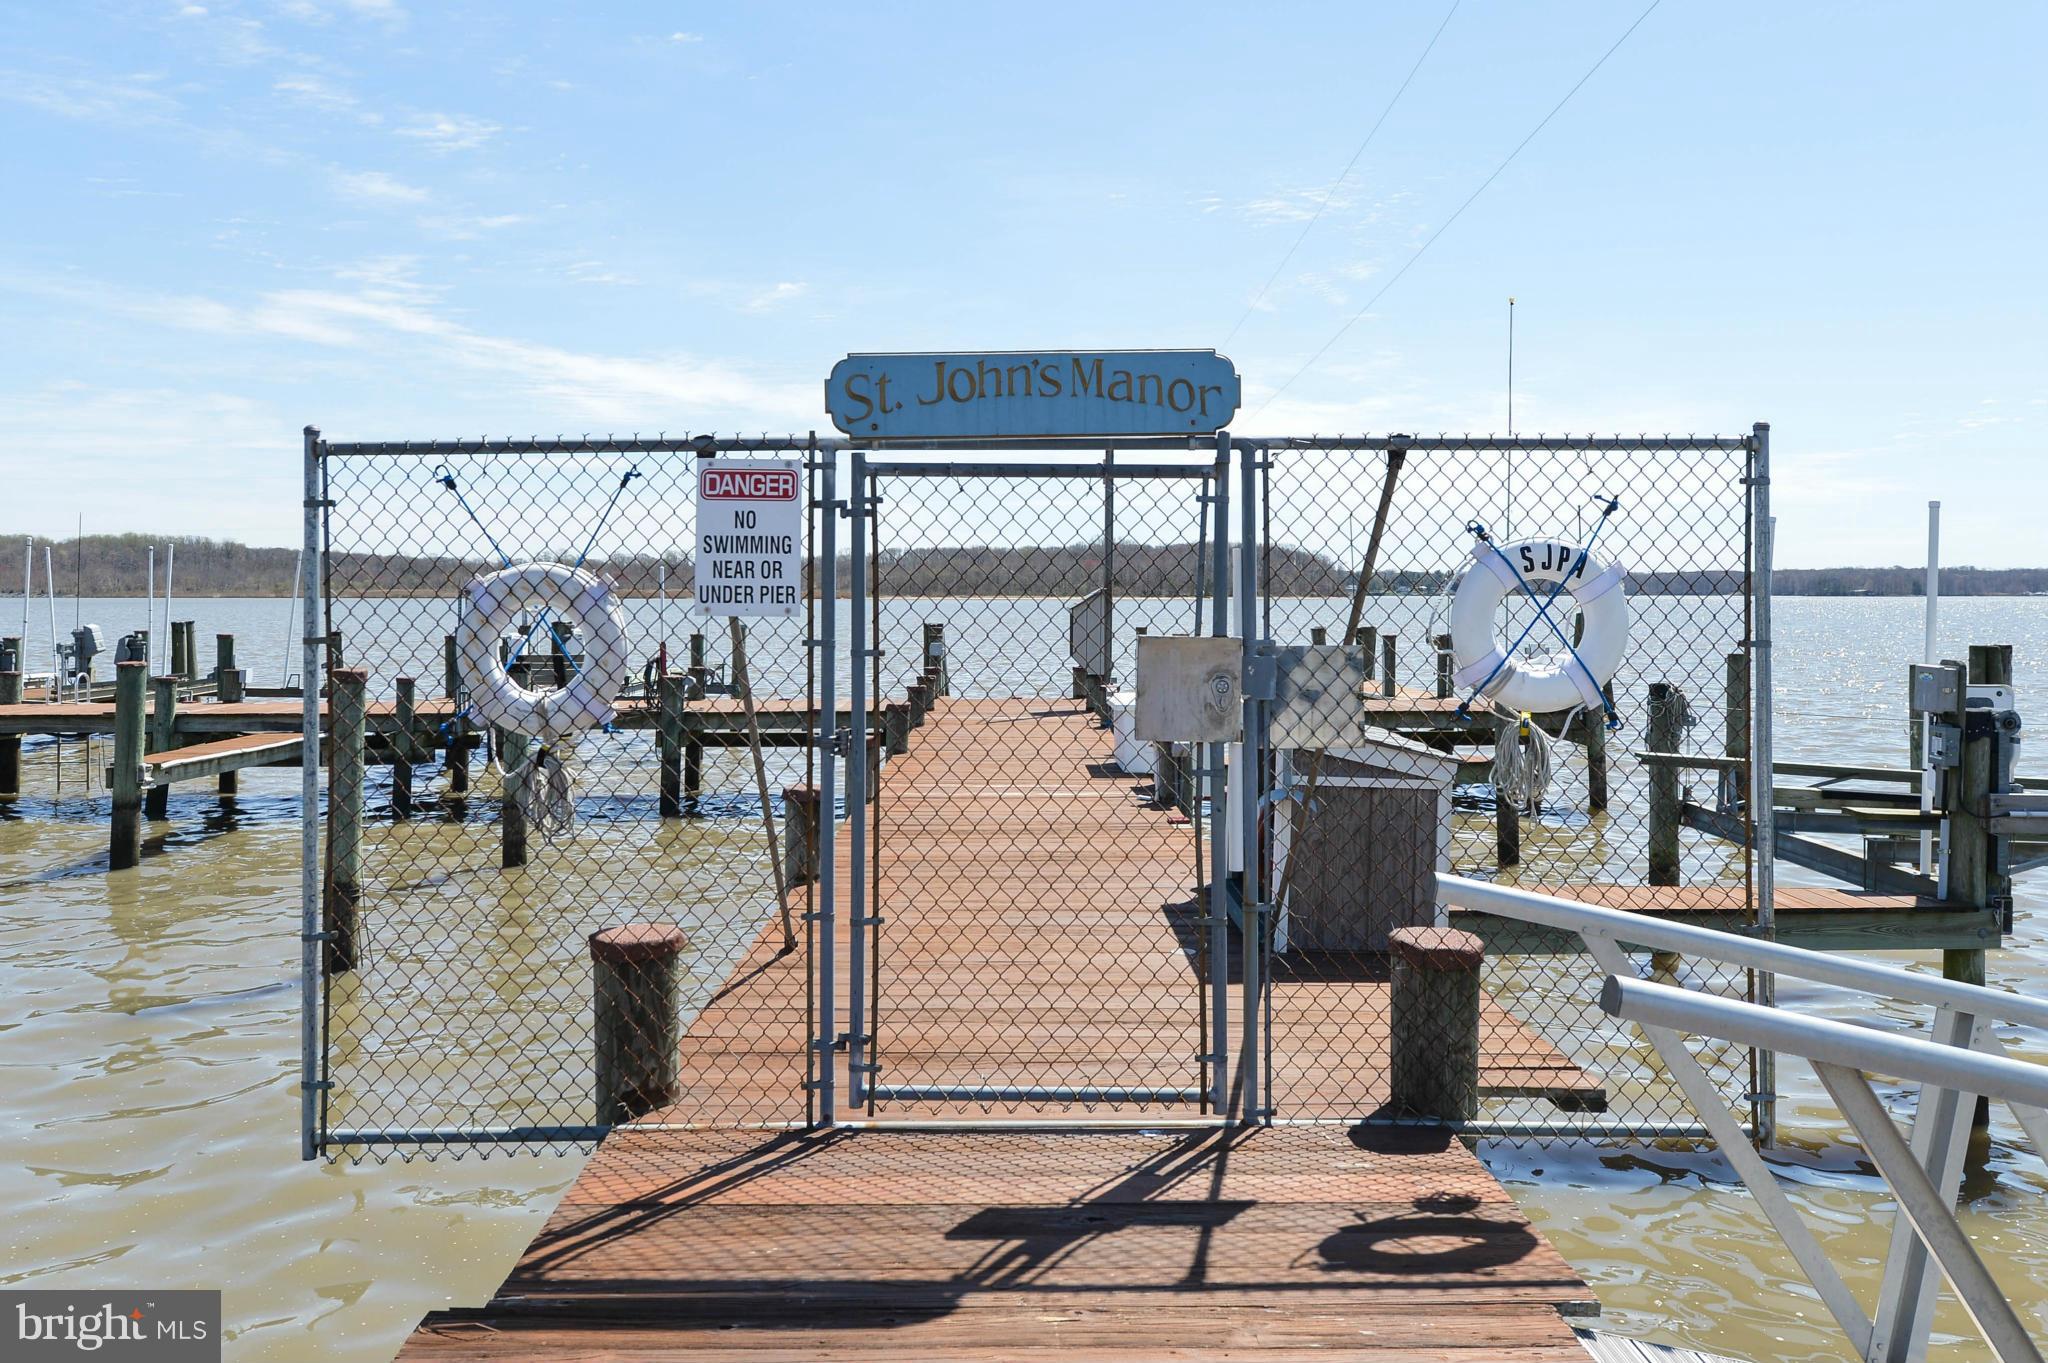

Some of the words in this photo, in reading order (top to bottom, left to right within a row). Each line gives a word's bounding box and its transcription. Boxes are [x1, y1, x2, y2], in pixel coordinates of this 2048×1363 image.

[843, 371, 904, 424] St.
[916, 358, 1063, 406] John's
[1070, 357, 1223, 417] Manor
[705, 473, 793, 496] DANGER
[734, 510, 757, 529] NO
[703, 535, 792, 554] SWIMMING
[712, 560, 755, 579] NEAR
[760, 560, 783, 579] OR
[1520, 543, 1588, 579] SJPA
[699, 585, 754, 604] UNDER
[760, 585, 796, 604] PIER
